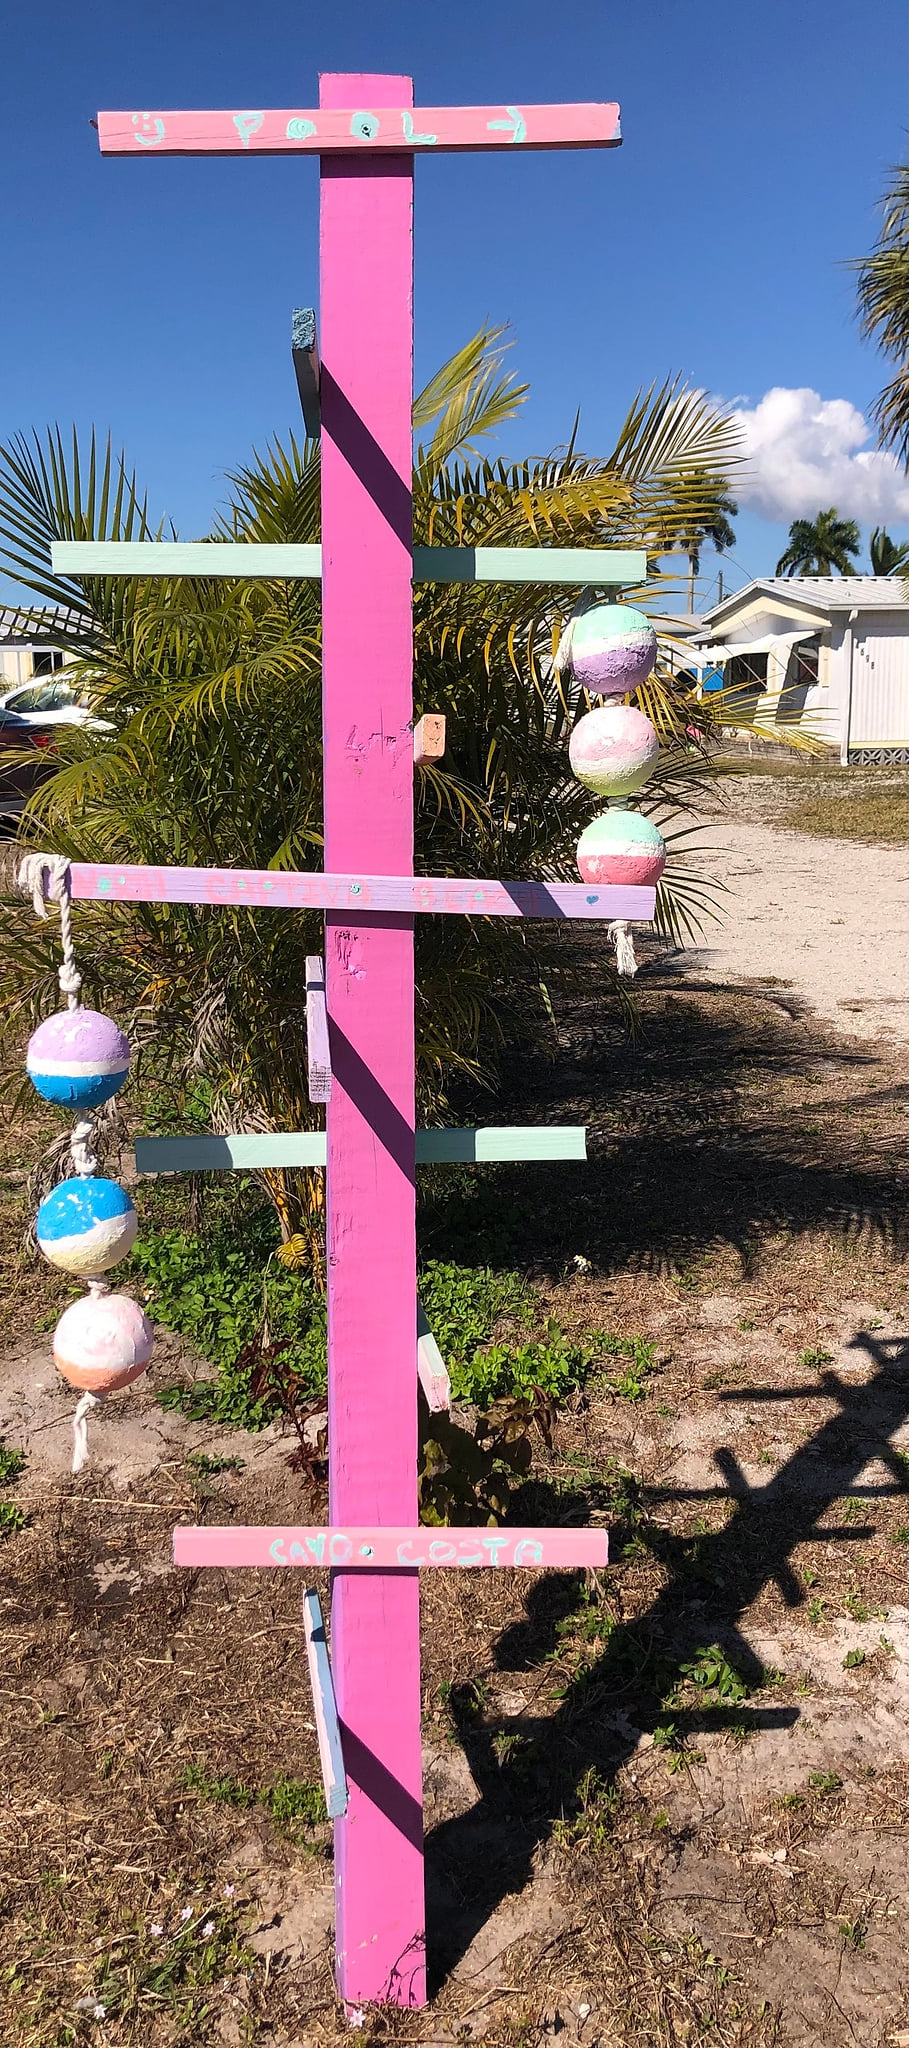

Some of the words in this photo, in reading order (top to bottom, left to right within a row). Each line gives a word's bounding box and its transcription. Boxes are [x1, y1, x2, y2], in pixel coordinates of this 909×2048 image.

[232, 112, 439, 147] POOL
[269, 1533, 351, 1563] CAYO
[397, 1537, 545, 1566] COSTA
